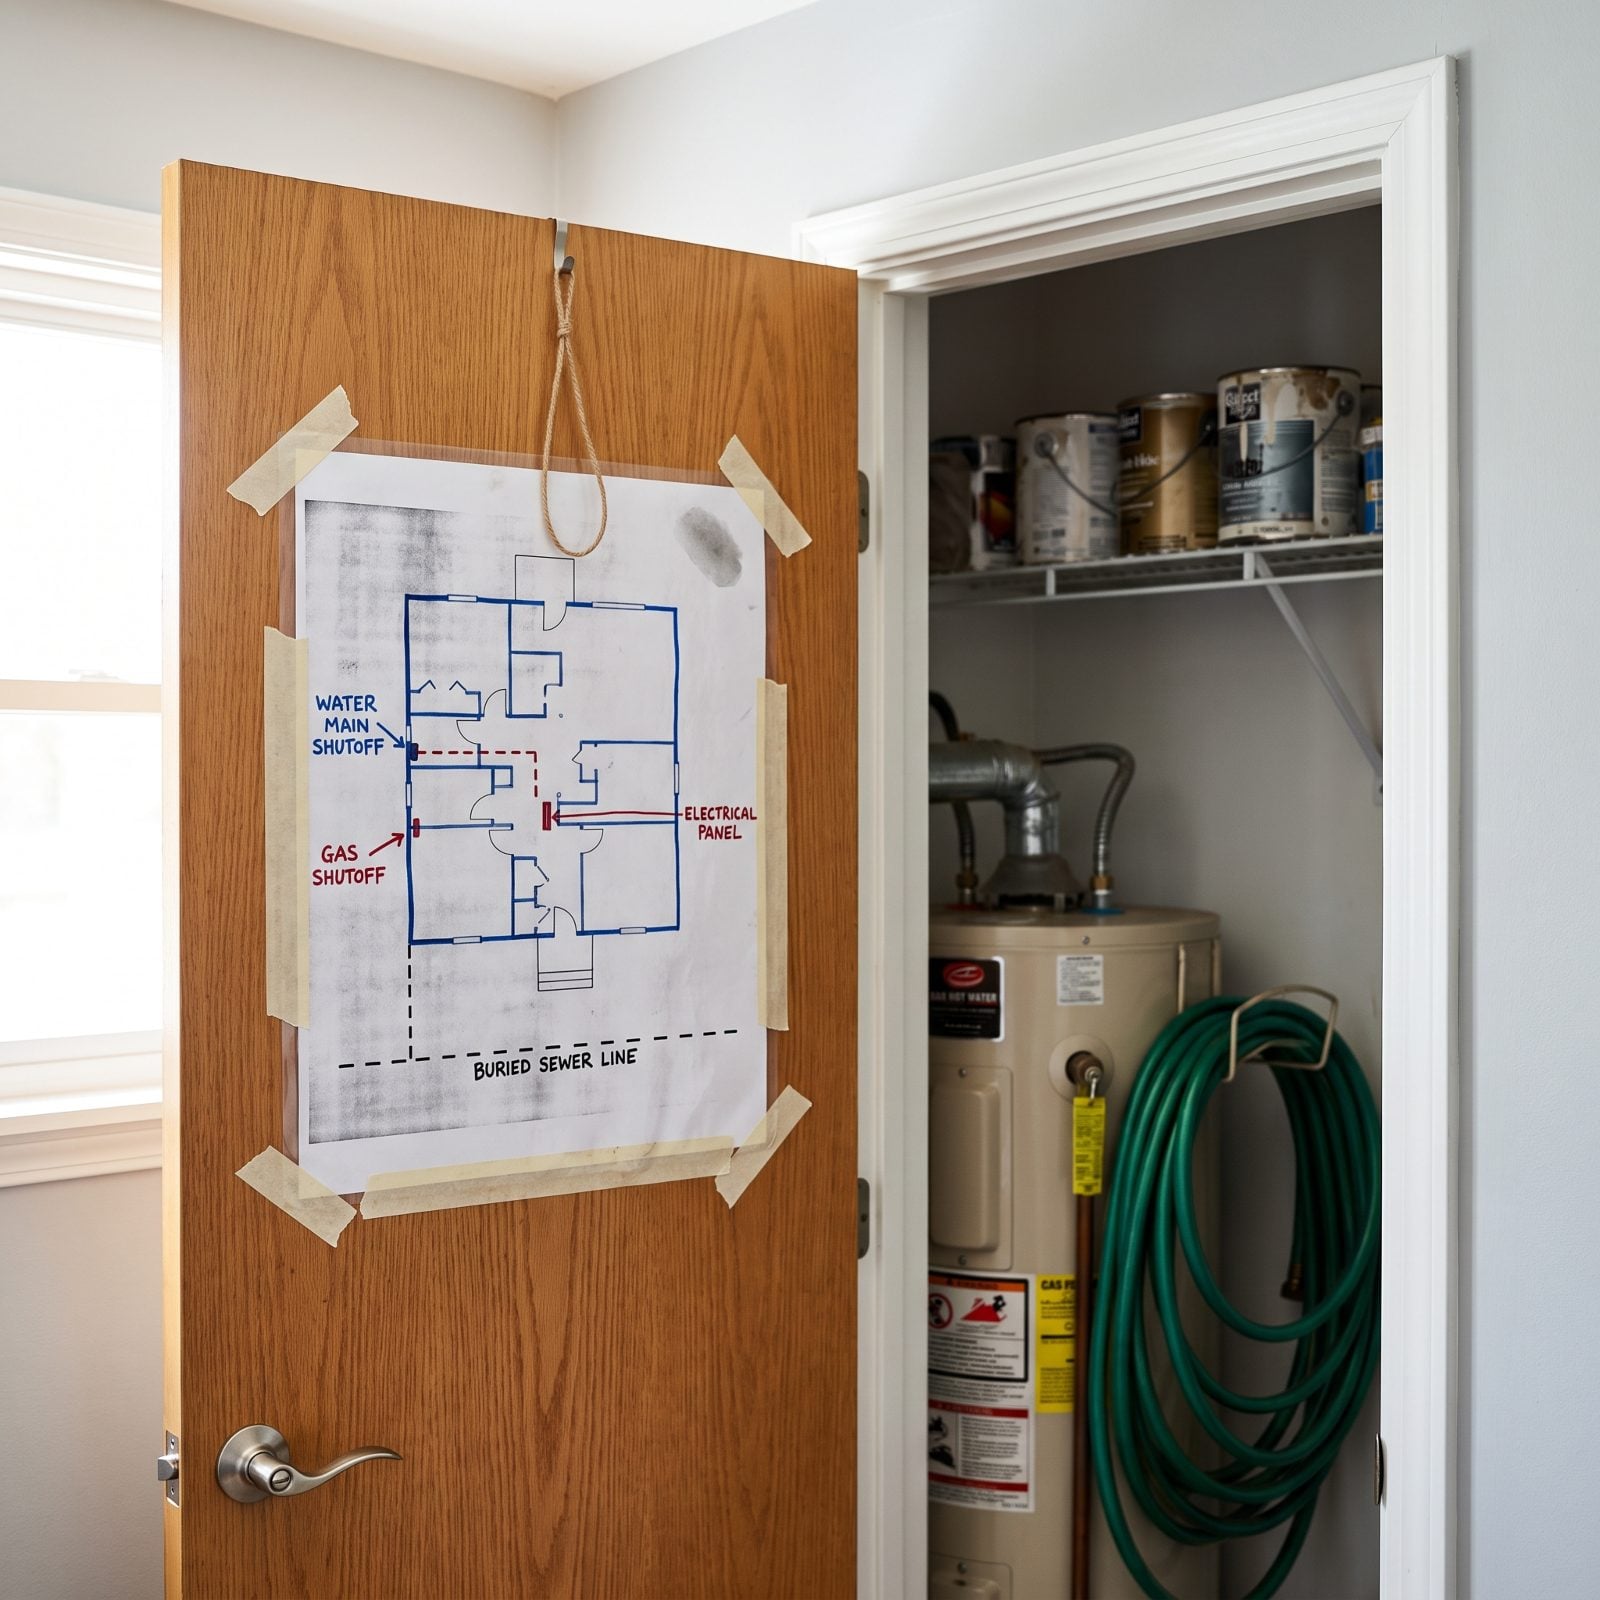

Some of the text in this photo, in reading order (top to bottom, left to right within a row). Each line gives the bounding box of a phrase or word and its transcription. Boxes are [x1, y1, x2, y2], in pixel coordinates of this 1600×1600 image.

[315, 694, 378, 712] WATER
[324, 717, 369, 733] MAIN
[312, 738, 385, 756] SHUTOFF
[685, 806, 757, 820] ELECTRICAL
[698, 824, 742, 840] PANEL
[321, 844, 358, 863] GAS
[312, 866, 386, 886] SHUTOFF
[967, 992, 998, 1003] WATER
[474, 1048, 638, 1081] BURIED SEWER LINE
